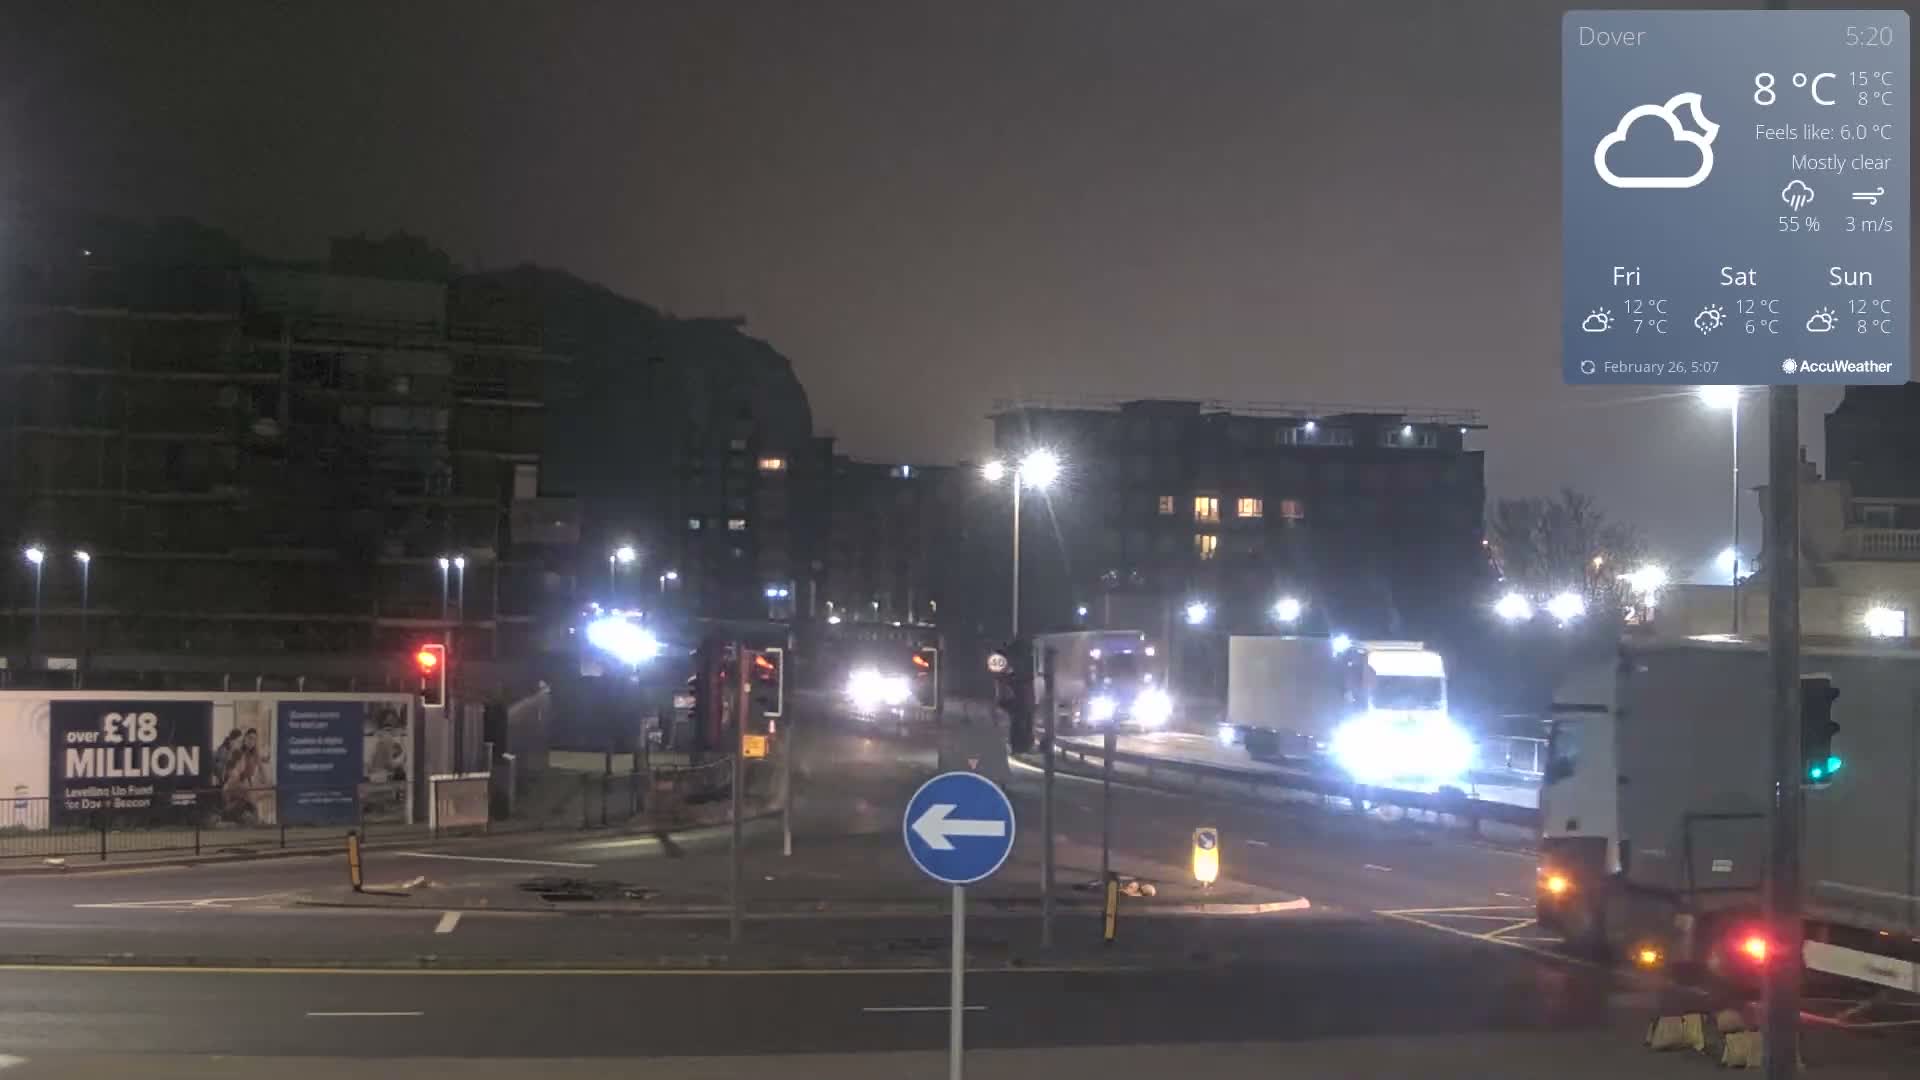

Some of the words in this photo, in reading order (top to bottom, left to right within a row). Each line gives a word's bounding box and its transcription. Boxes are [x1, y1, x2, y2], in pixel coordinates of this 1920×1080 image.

[66, 731, 99, 743] over
[104, 711, 158, 743] £18
[66, 745, 200, 778] MILLION
